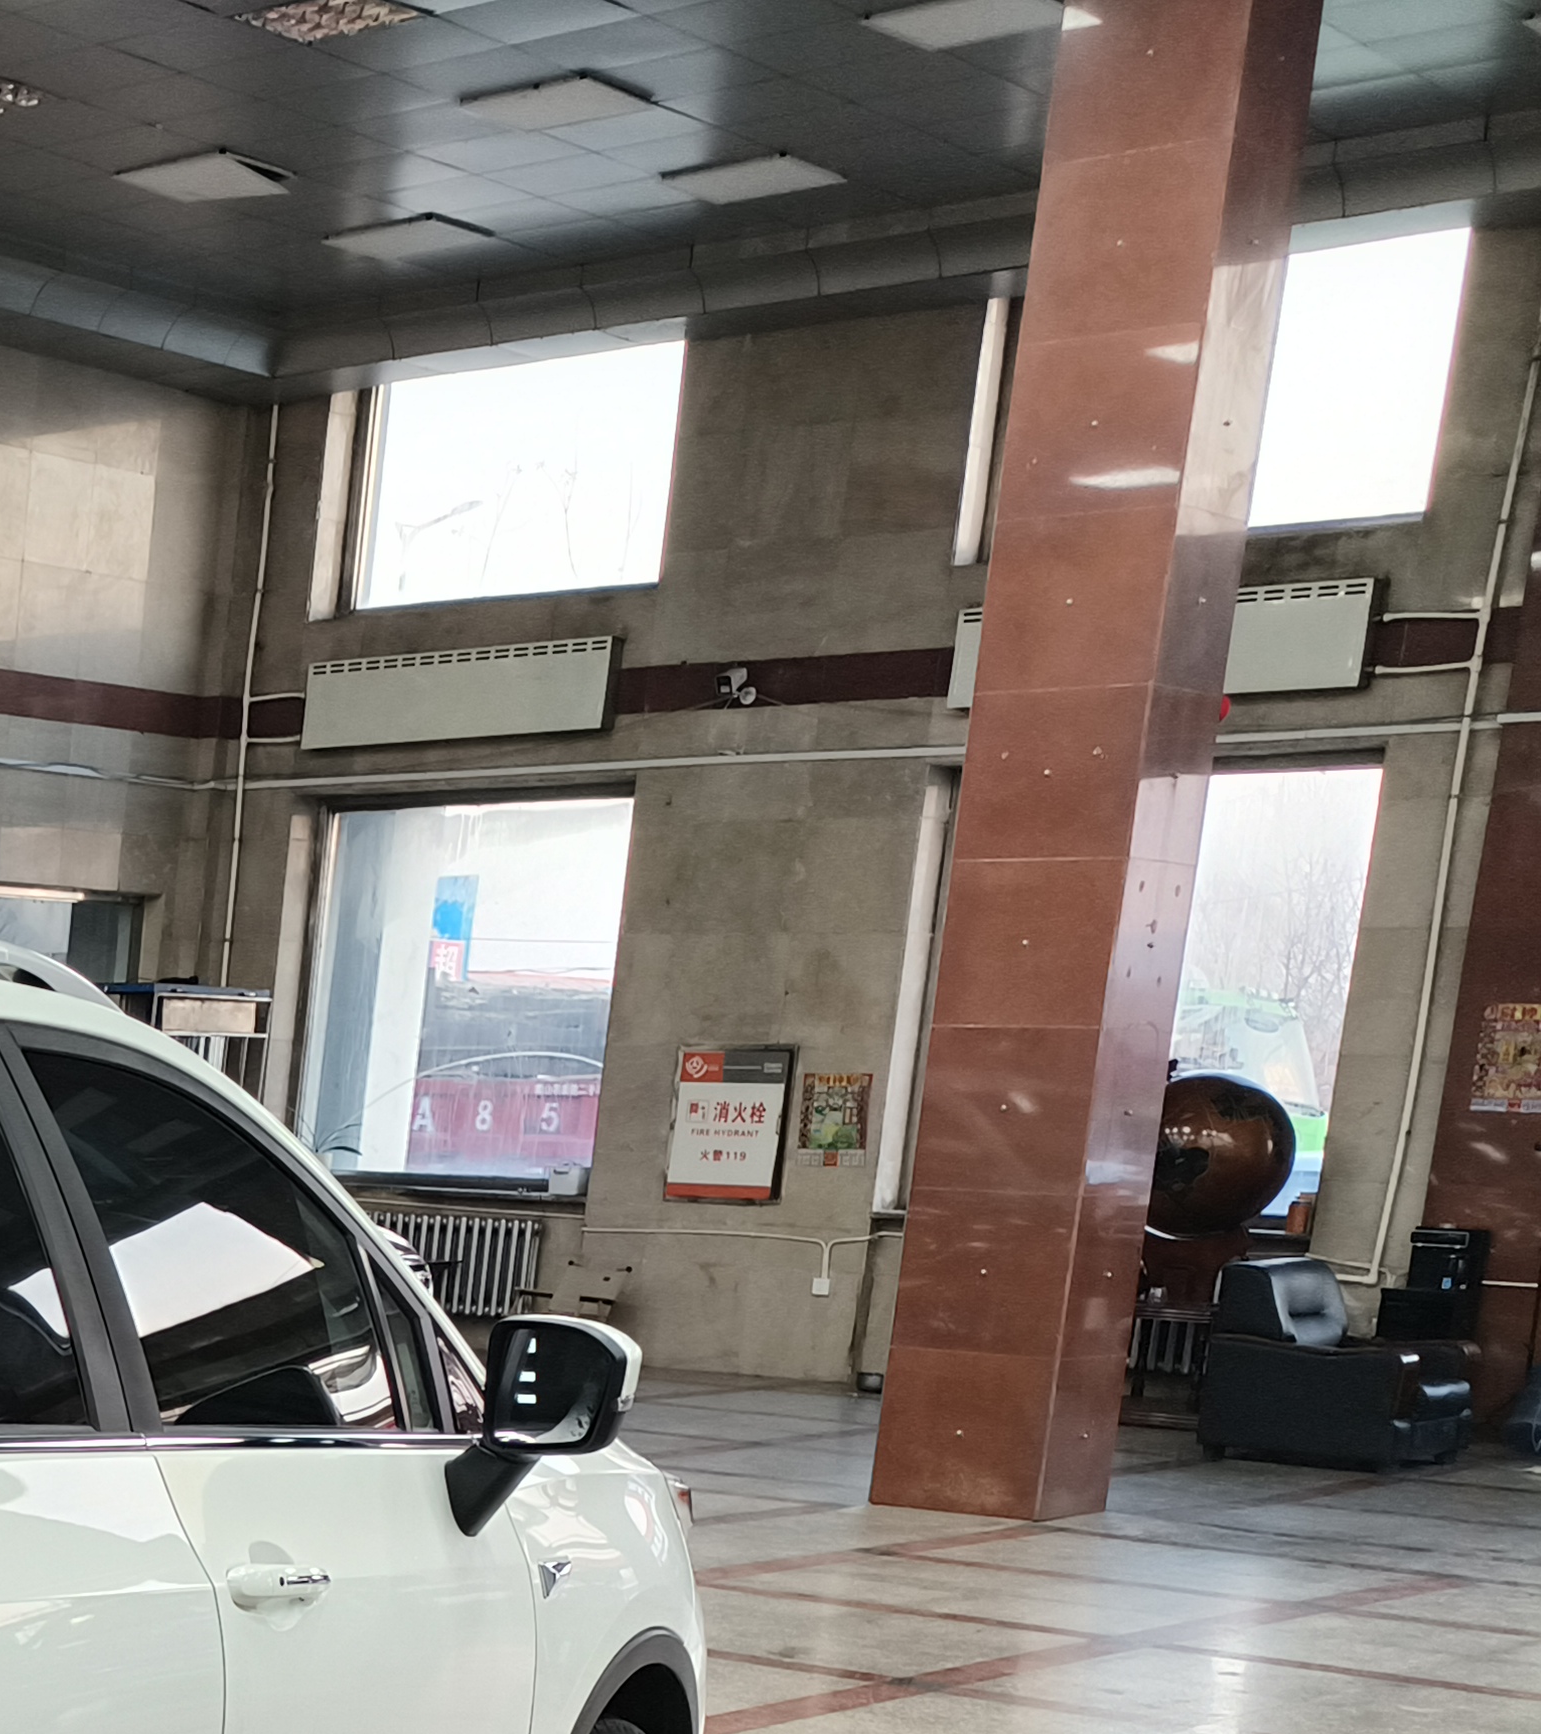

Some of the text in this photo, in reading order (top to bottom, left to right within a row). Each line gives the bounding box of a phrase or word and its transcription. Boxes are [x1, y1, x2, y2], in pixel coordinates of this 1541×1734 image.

[474, 1100, 494, 1132] 8
[540, 1101, 560, 1132] 5
[712, 1100, 767, 1125] 消火栓
[691, 1128, 760, 1138] FIRE HYDRANT
[699, 1149, 747, 1162] 火警119
